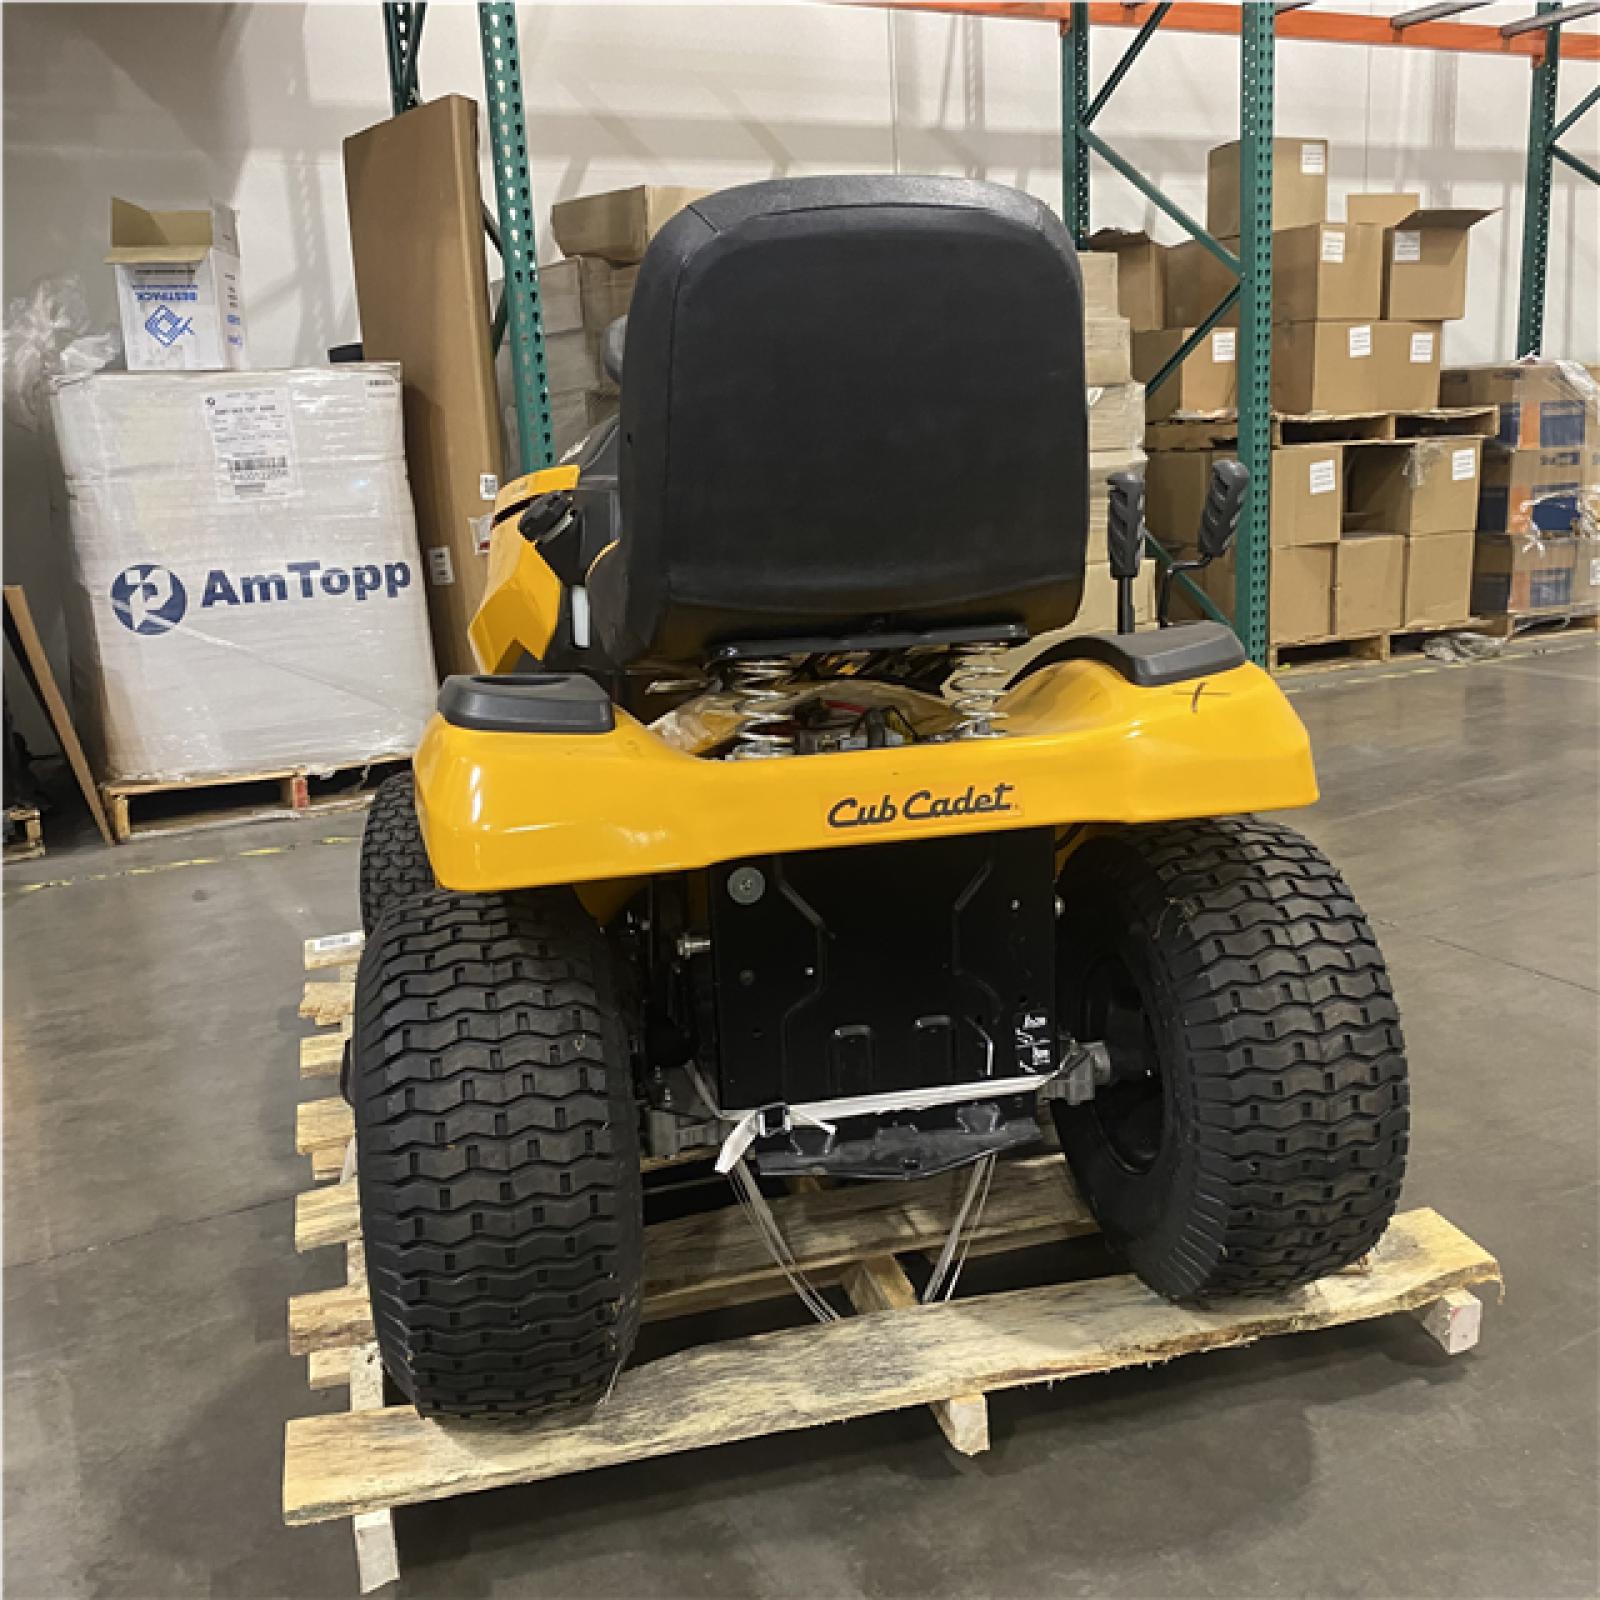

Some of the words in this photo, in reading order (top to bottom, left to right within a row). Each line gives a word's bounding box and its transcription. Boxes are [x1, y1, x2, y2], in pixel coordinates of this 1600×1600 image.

[202, 560, 411, 608] AmTopp
[828, 795, 897, 828] Cub
[902, 782, 1015, 820] Cadet
